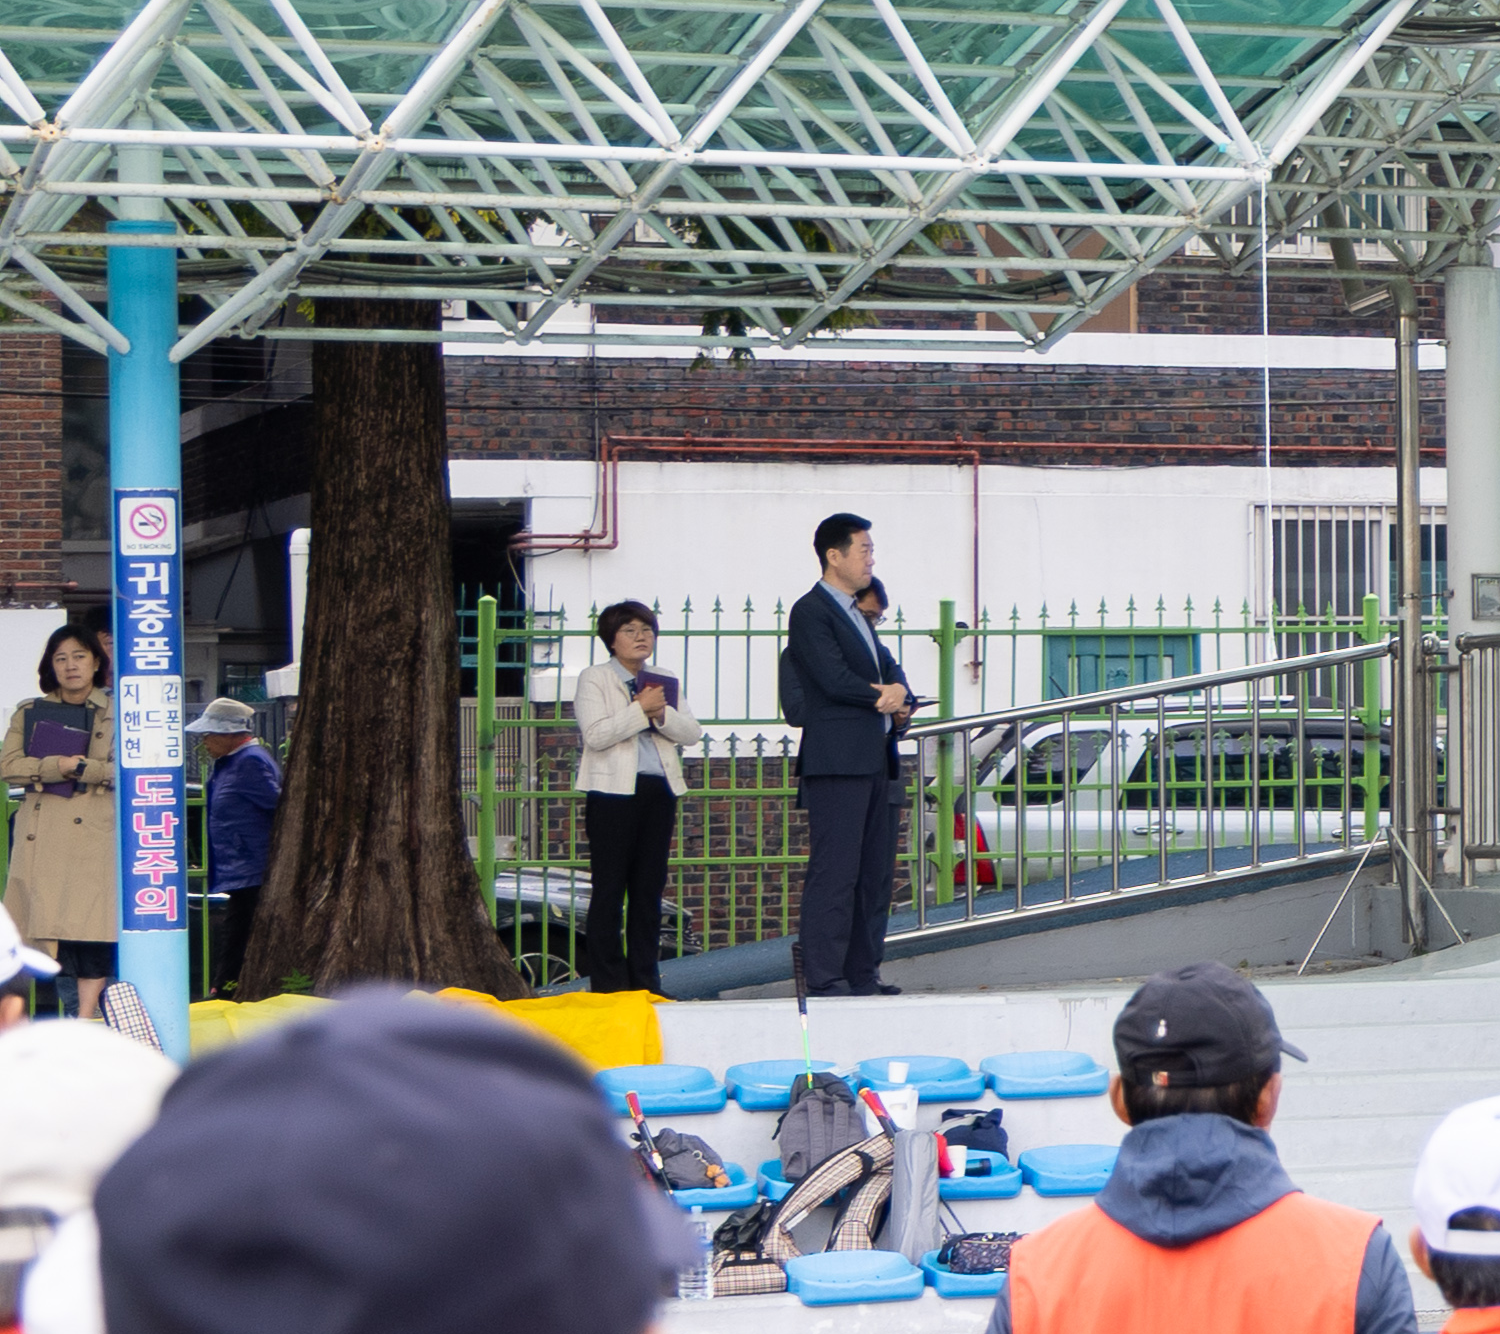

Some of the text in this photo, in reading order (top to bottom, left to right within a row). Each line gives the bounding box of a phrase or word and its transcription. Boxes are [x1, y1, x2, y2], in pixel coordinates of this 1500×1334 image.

[128, 562, 173, 670] 귀중품
[124, 710, 180, 732] 핸드폰
[132, 772, 179, 923] 도난주의
